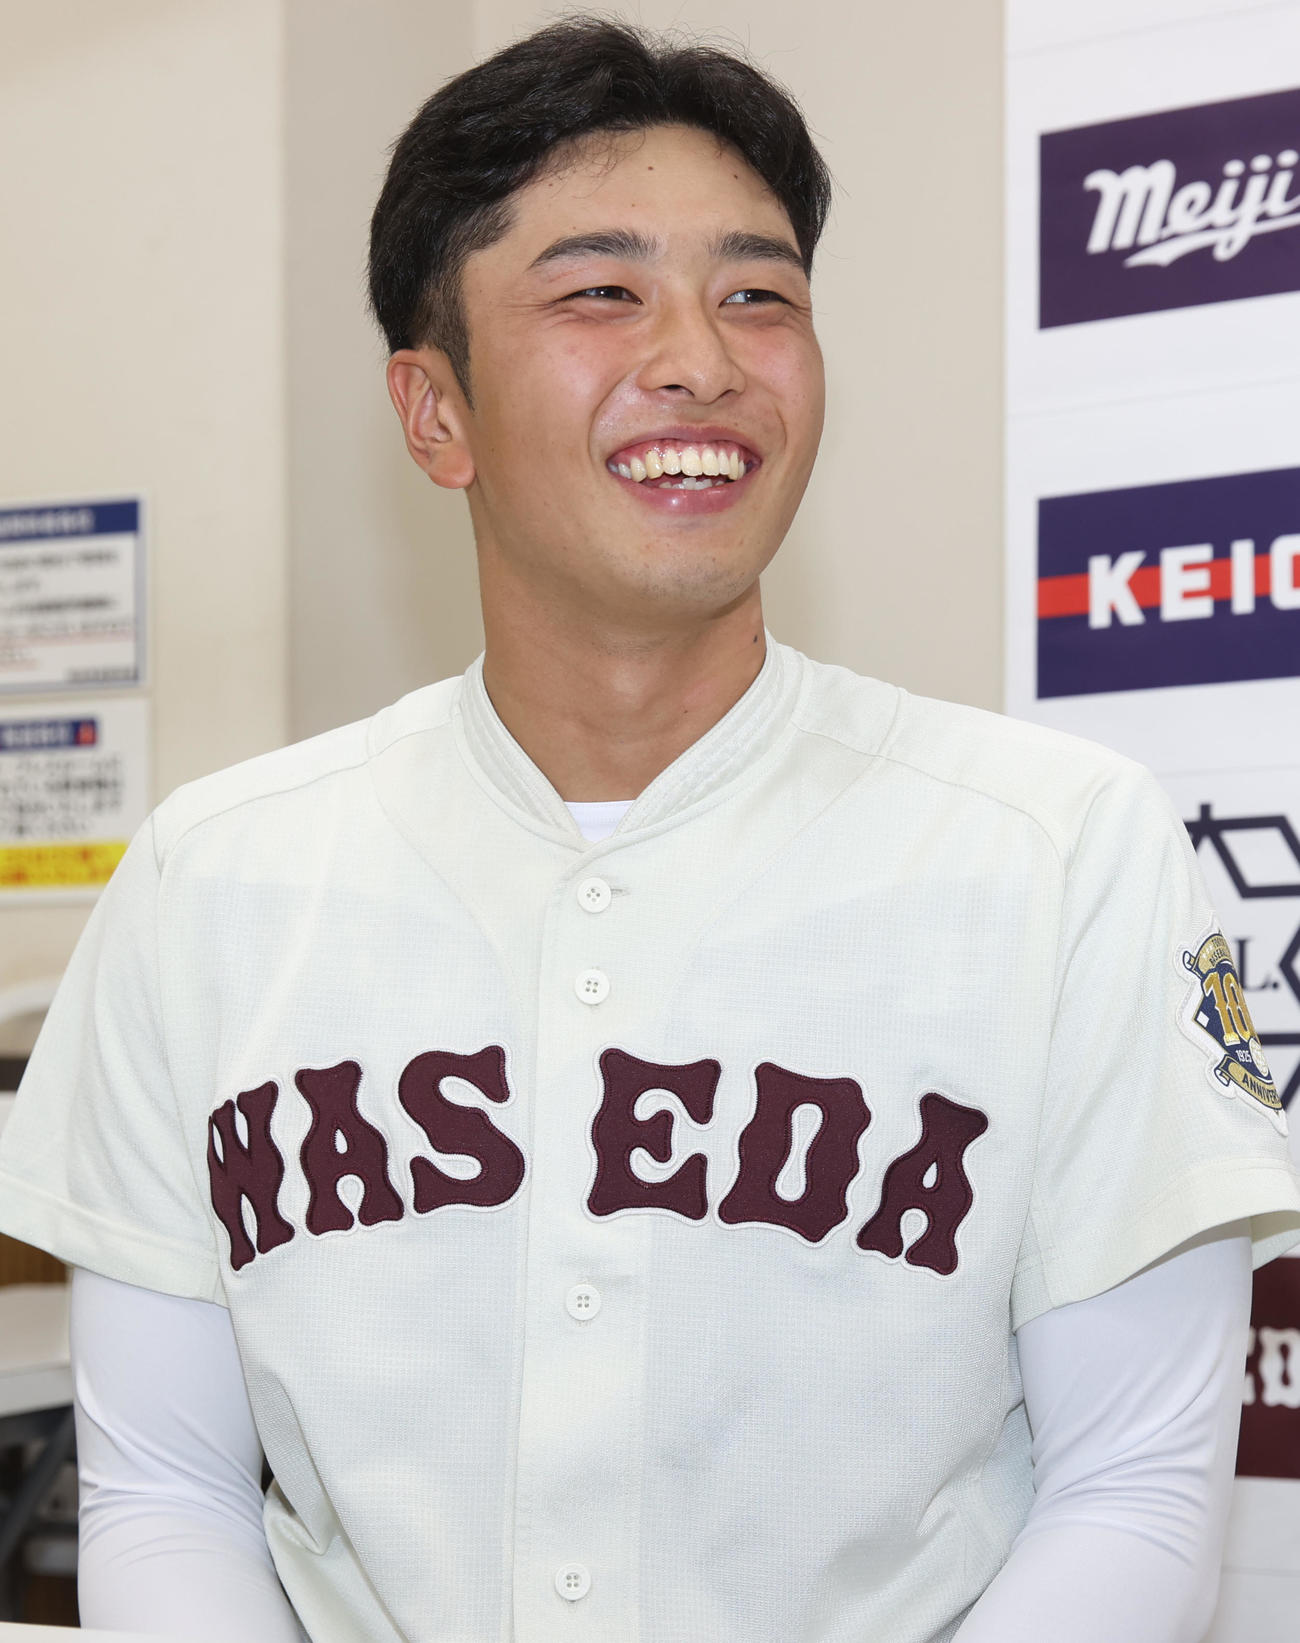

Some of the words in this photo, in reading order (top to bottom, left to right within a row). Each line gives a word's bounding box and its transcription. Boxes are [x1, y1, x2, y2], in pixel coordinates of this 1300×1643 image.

[1083, 149, 1300, 264] Meiji
[1203, 971, 1256, 1046] 10
[1242, 1072, 1281, 1105] ANNIVER
[206, 1045, 988, 1276] WASEDA
